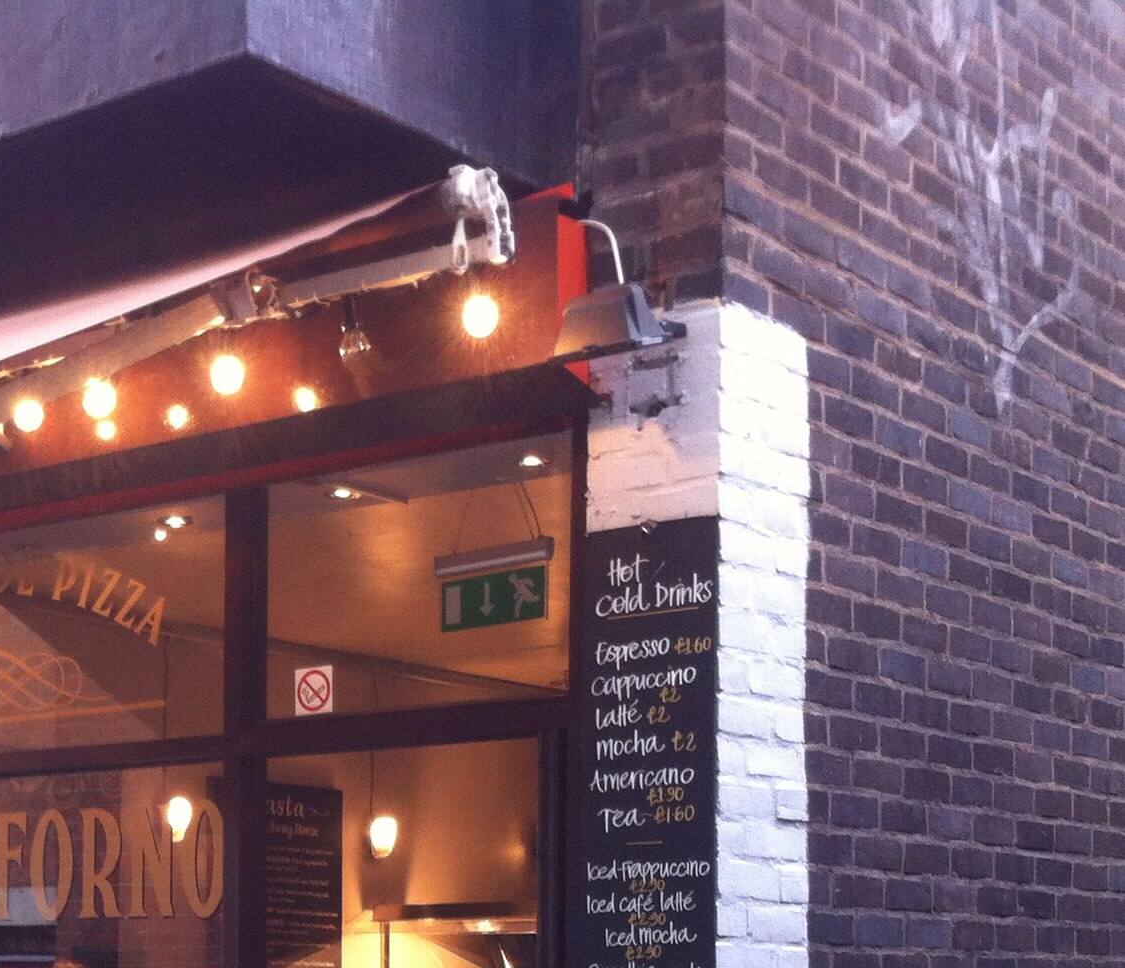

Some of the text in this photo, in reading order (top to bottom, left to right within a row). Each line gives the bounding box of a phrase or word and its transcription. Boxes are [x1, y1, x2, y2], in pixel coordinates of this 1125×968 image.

[607, 553, 649, 586] Hot
[52, 560, 165, 648] PIZZA
[596, 573, 714, 617] Cold Drinks
[595, 637, 670, 670] Espresso
[647, 706, 671, 724] £2
[671, 730, 697, 751] £2
[589, 767, 695, 793] Americano
[597, 808, 646, 833] Tea
[586, 892, 616, 914] Iced
[605, 924, 637, 947] Iced
